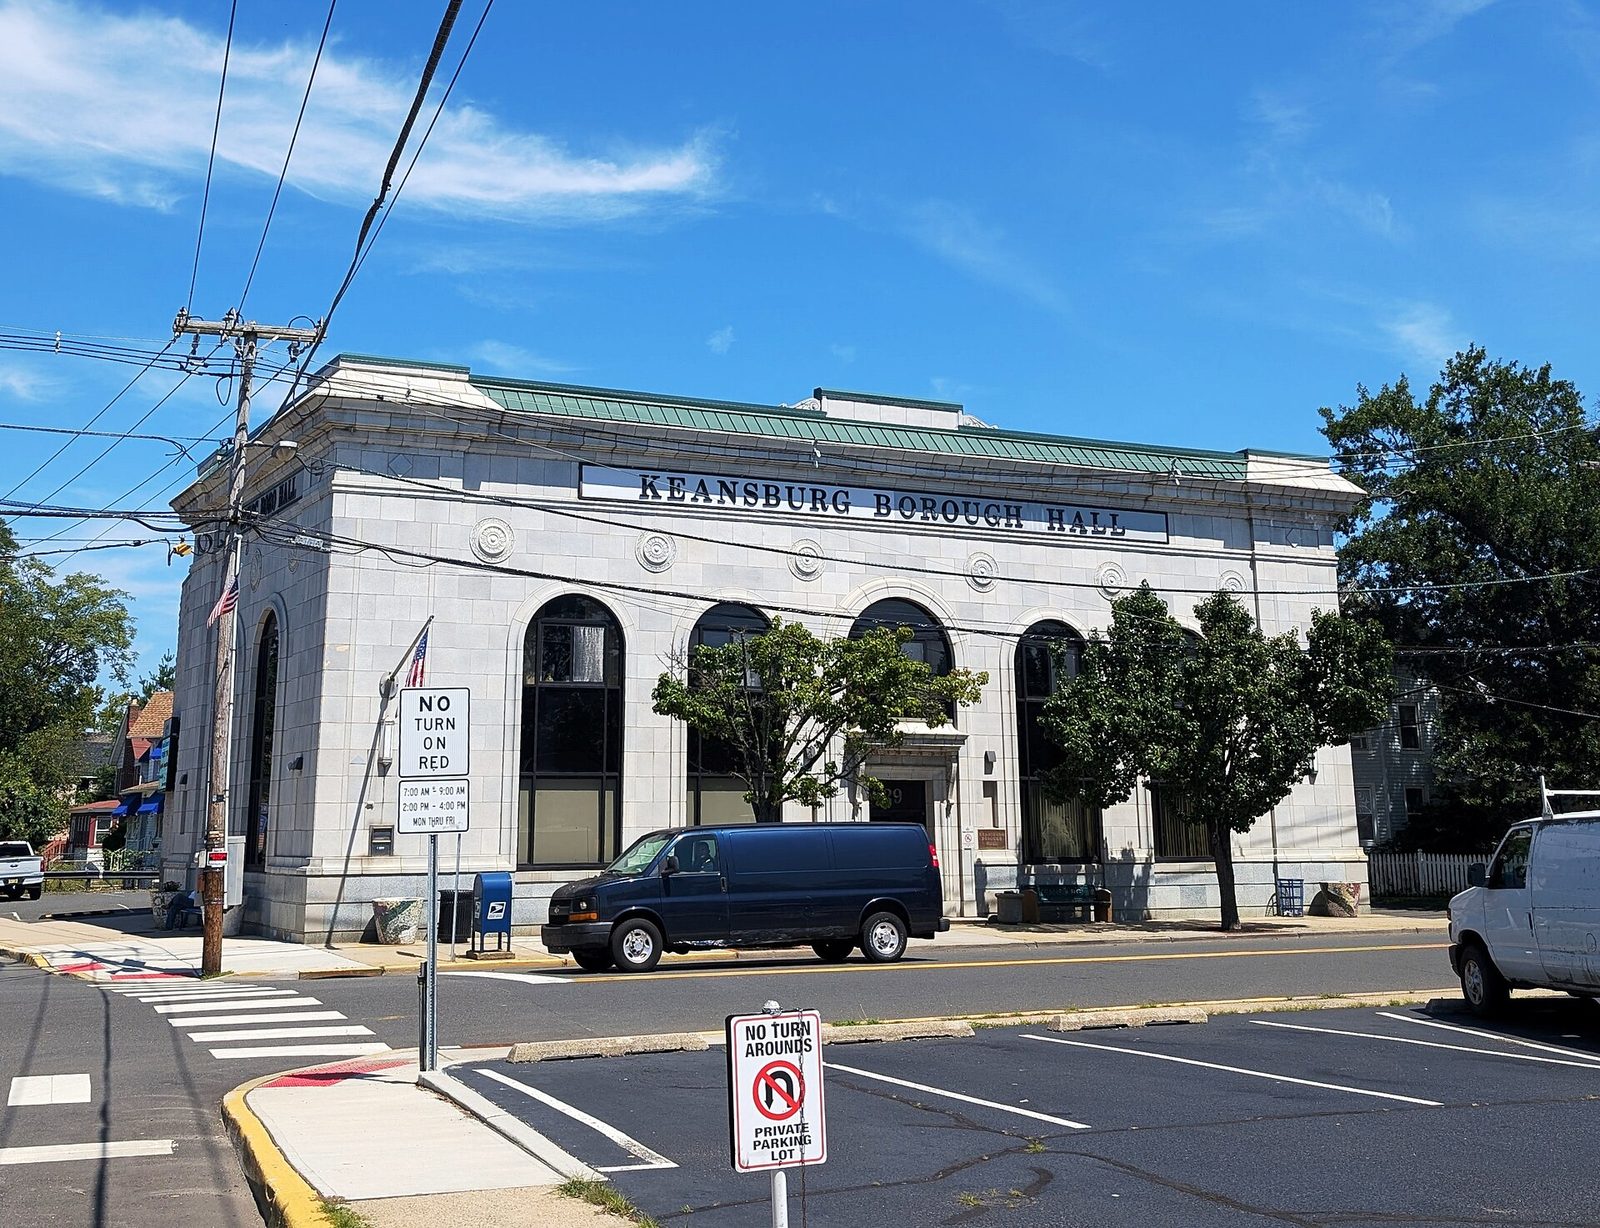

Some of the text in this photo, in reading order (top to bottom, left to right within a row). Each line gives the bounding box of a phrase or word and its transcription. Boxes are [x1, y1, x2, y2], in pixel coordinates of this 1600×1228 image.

[638, 474, 1126, 536] KEANSBURG BOROUGH HALL
[419, 695, 451, 712] NO
[414, 717, 456, 731] TURN
[423, 736, 446, 750] ON
[419, 755, 449, 770] RED
[403, 787, 418, 797] 7:00
[420, 787, 430, 796] AM
[439, 786, 454, 796] 9:00
[456, 786, 465, 795] AM
[402, 802, 418, 812] 2:00
[420, 802, 429, 811] PM
[439, 801, 455, 811] 4:00
[457, 801, 466, 810] PM
[412, 816, 455, 826] MON THRU FRI
[745, 1021, 811, 1041] NO TURN
[745, 1038, 813, 1058] AROUNDS
[754, 1122, 810, 1138] PRIVATE
[753, 1135, 812, 1151] PARKING
[771, 1148, 795, 1161] LOT
